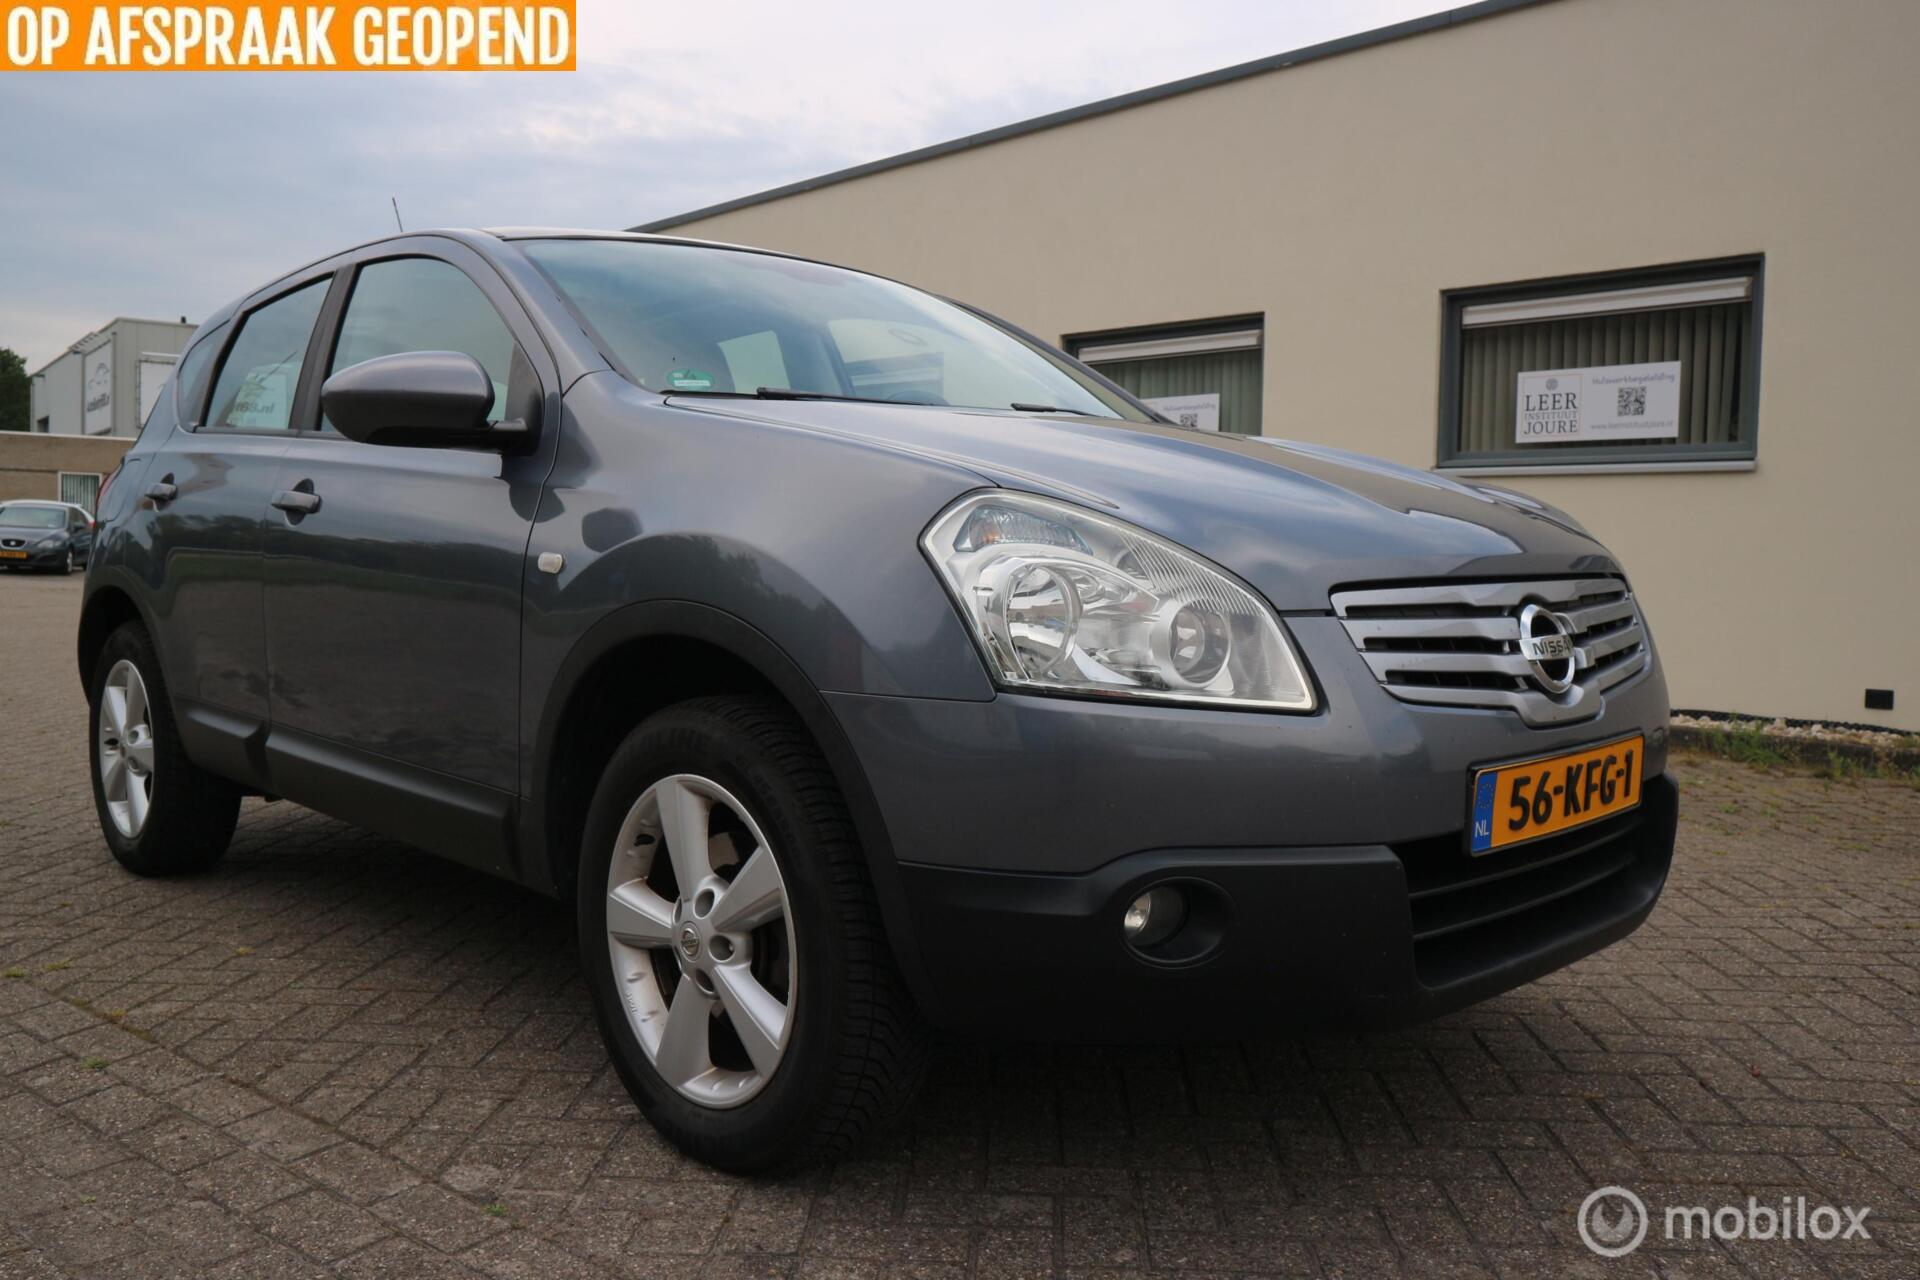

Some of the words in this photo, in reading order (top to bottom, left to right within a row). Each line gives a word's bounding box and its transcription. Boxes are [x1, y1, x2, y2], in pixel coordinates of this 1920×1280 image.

[1525, 392, 1578, 411] LEER
[1523, 420, 1578, 435] JOURE
[1508, 749, 1634, 831] 56-KFG-1
[1474, 819, 1490, 838] NL
